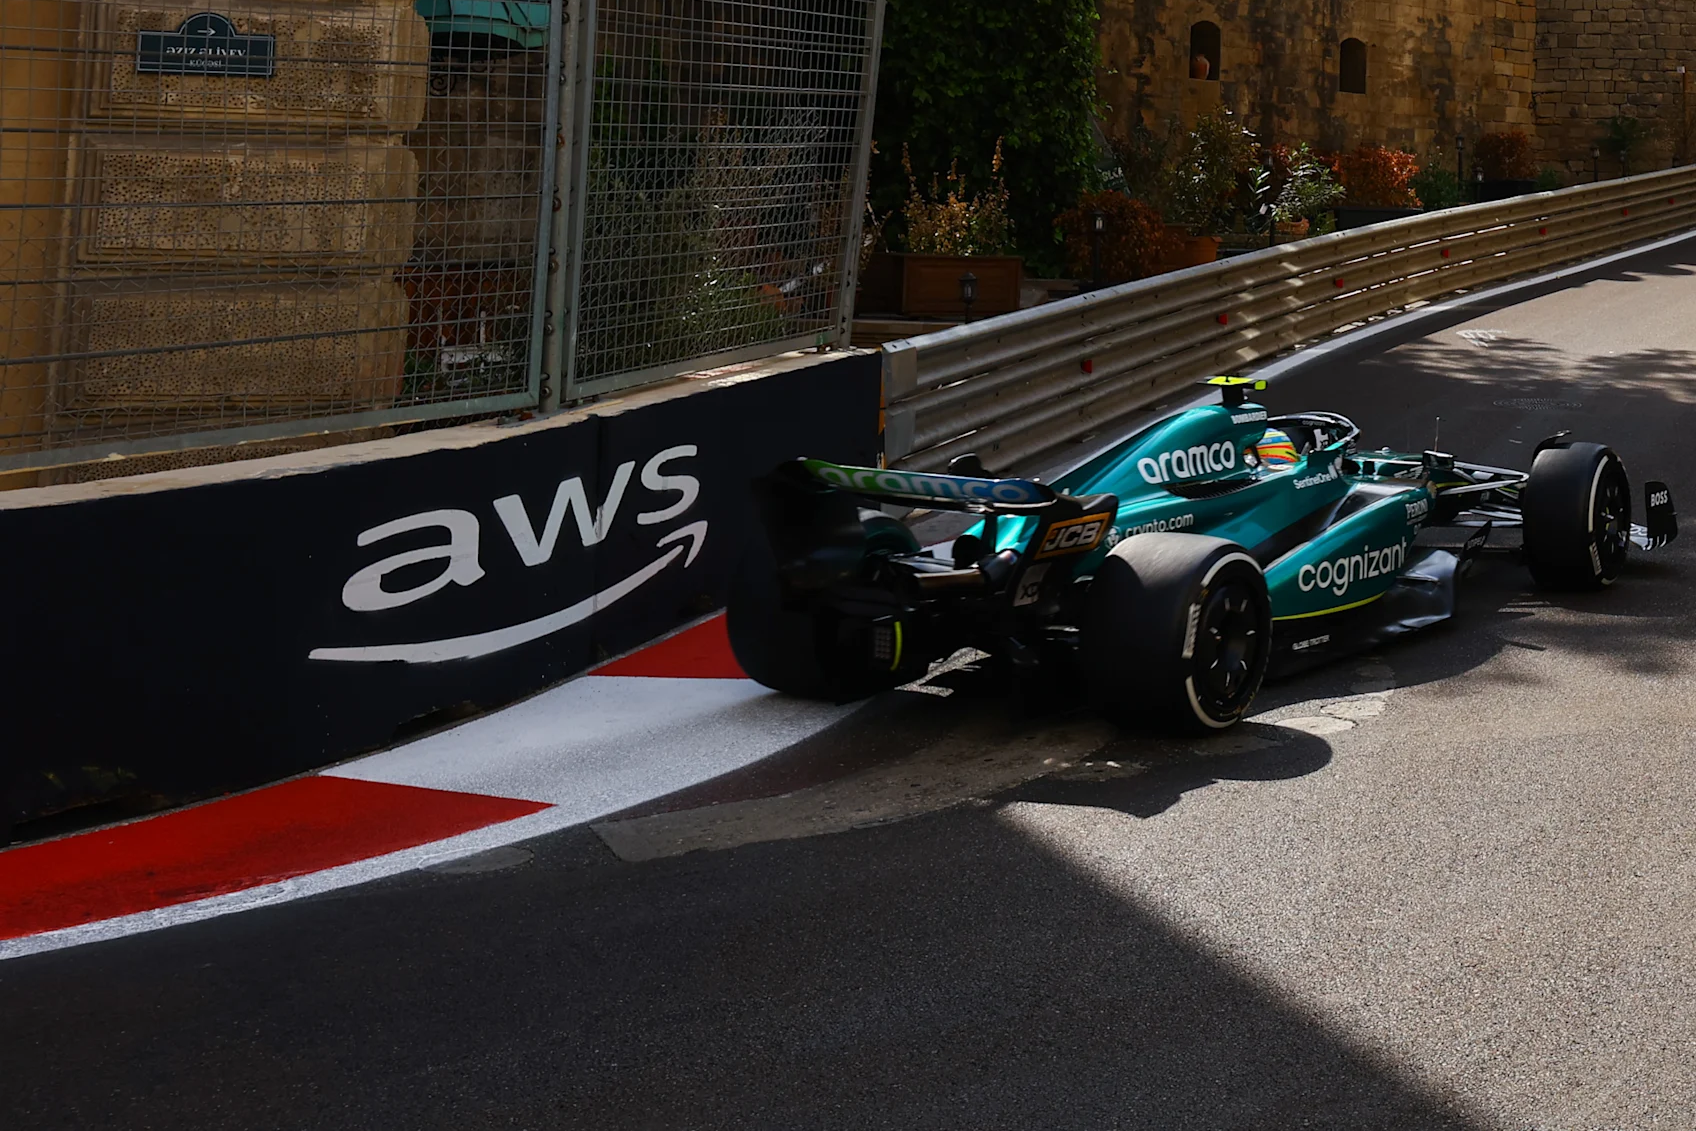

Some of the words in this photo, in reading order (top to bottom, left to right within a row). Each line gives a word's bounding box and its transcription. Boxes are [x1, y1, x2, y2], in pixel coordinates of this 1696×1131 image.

[1137, 440, 1236, 484] aramco
[818, 467, 1031, 503] aramco
[1292, 471, 1334, 489] SentinelOne
[1405, 498, 1429, 520] PERONI
[1650, 490, 1668, 507] BOSS
[341, 444, 700, 612] aws
[1043, 521, 1102, 552] JCB
[1125, 513, 1194, 538] crypto.com
[1298, 536, 1407, 596] cognizant
